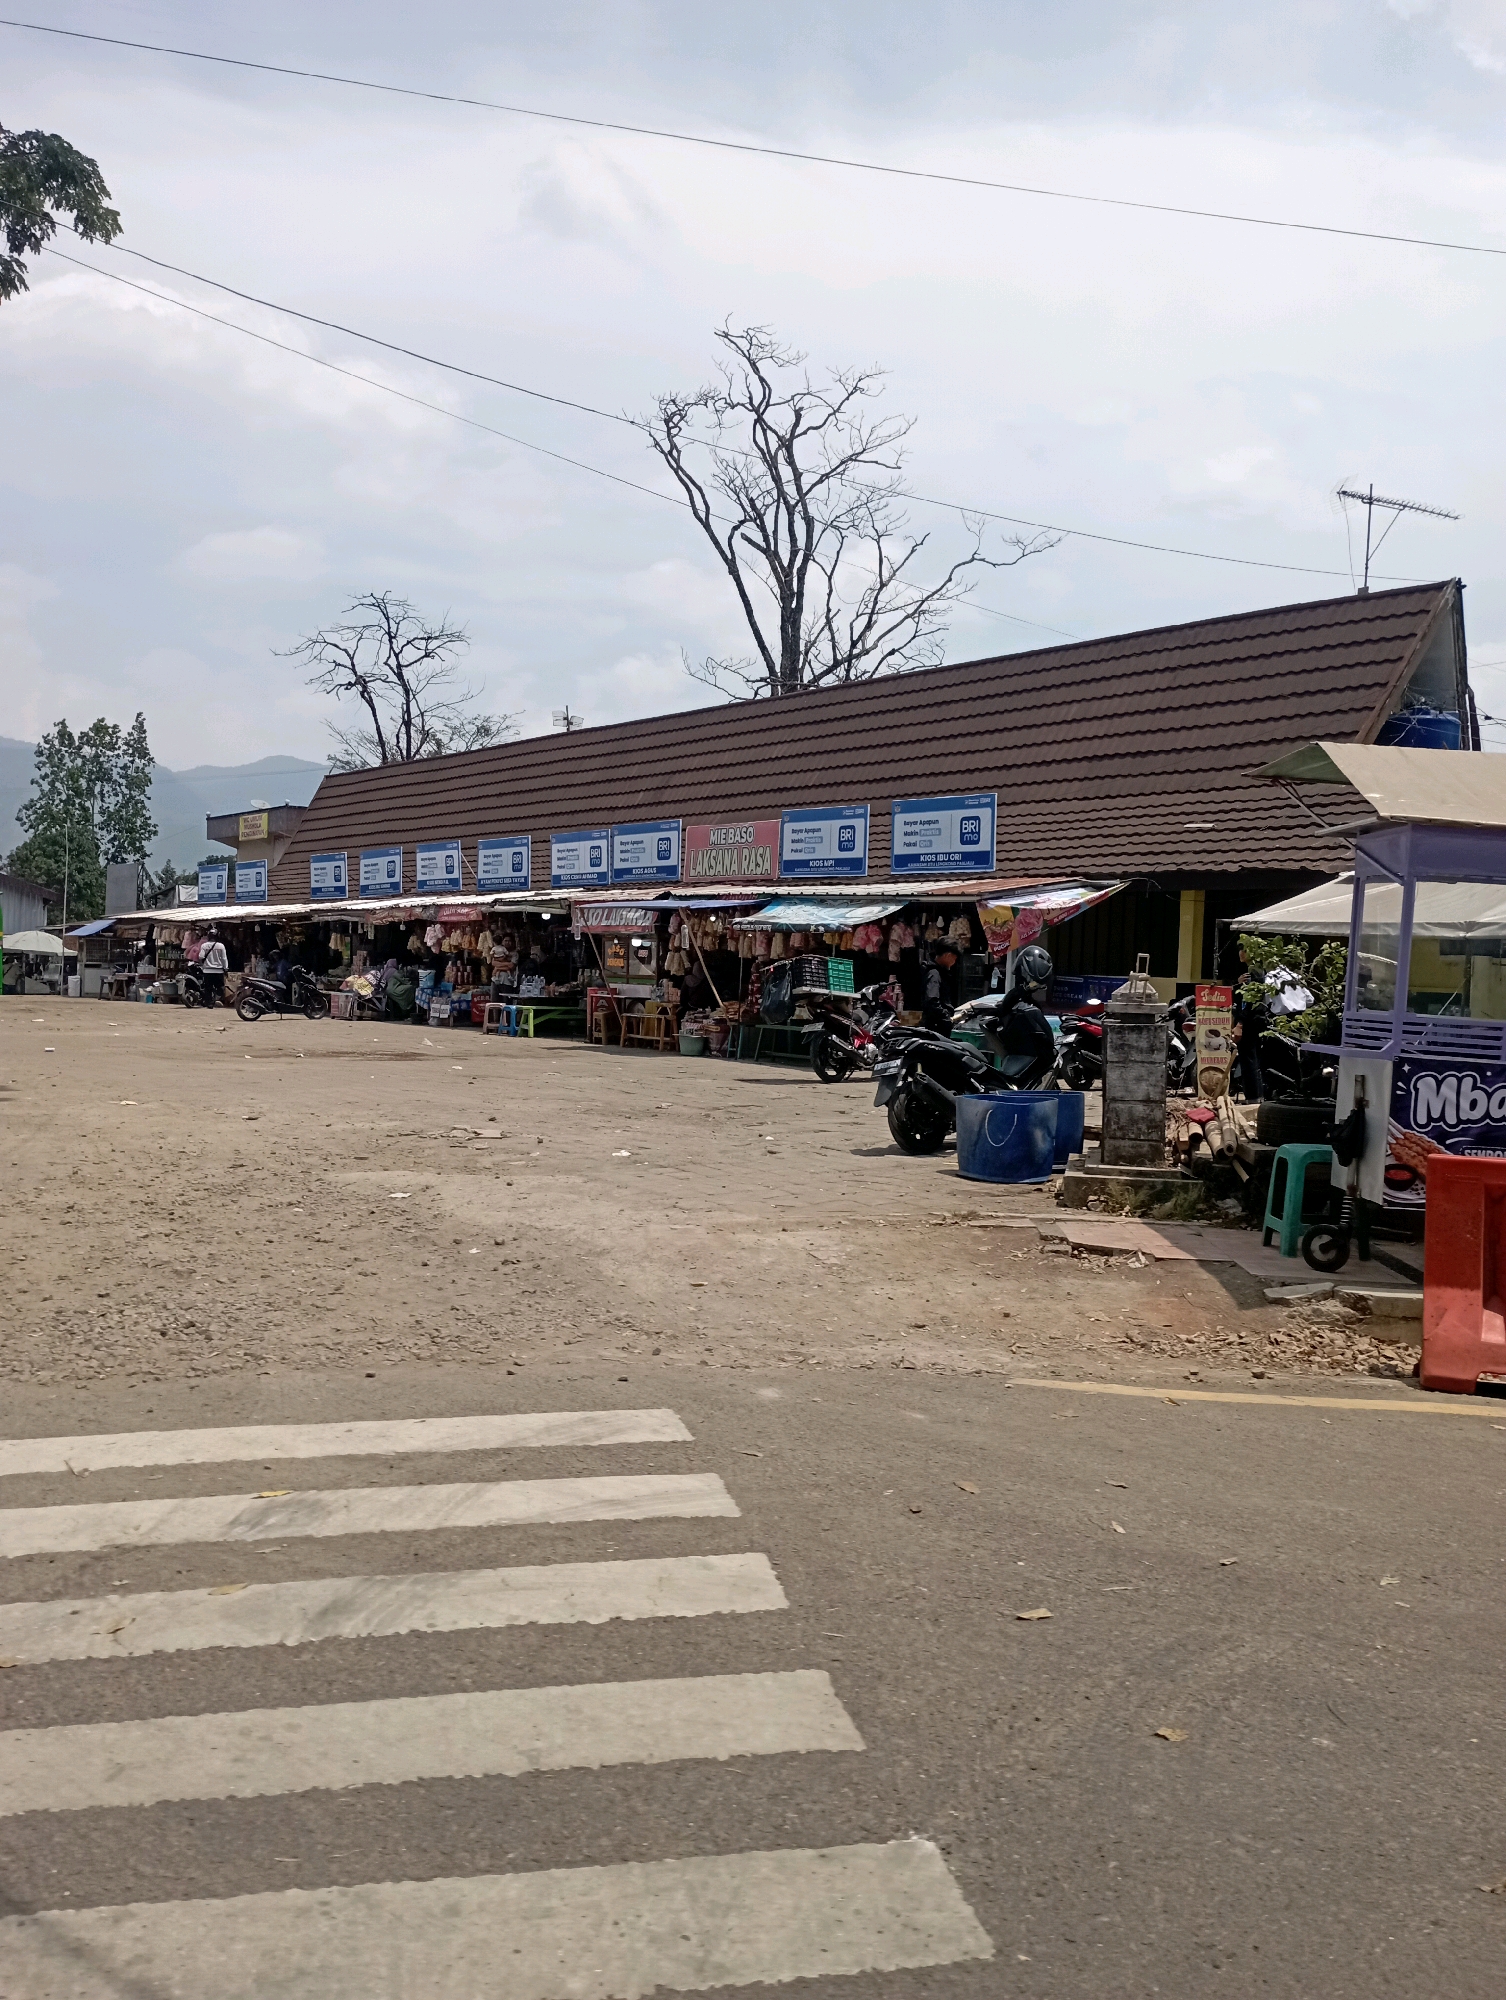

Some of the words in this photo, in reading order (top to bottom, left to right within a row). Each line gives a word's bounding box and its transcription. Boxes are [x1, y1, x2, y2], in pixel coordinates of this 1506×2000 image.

[962, 820, 979, 833] BRI
[709, 828, 727, 845] MIE
[728, 826, 754, 844] BASO
[840, 829, 854, 840] BRI
[659, 840, 670, 850] BRI
[591, 849, 600, 858] BRI
[689, 848, 738, 877] LAKSANA
[741, 846, 771, 875] RASA
[1201, 989, 1226, 1002] Sedia
